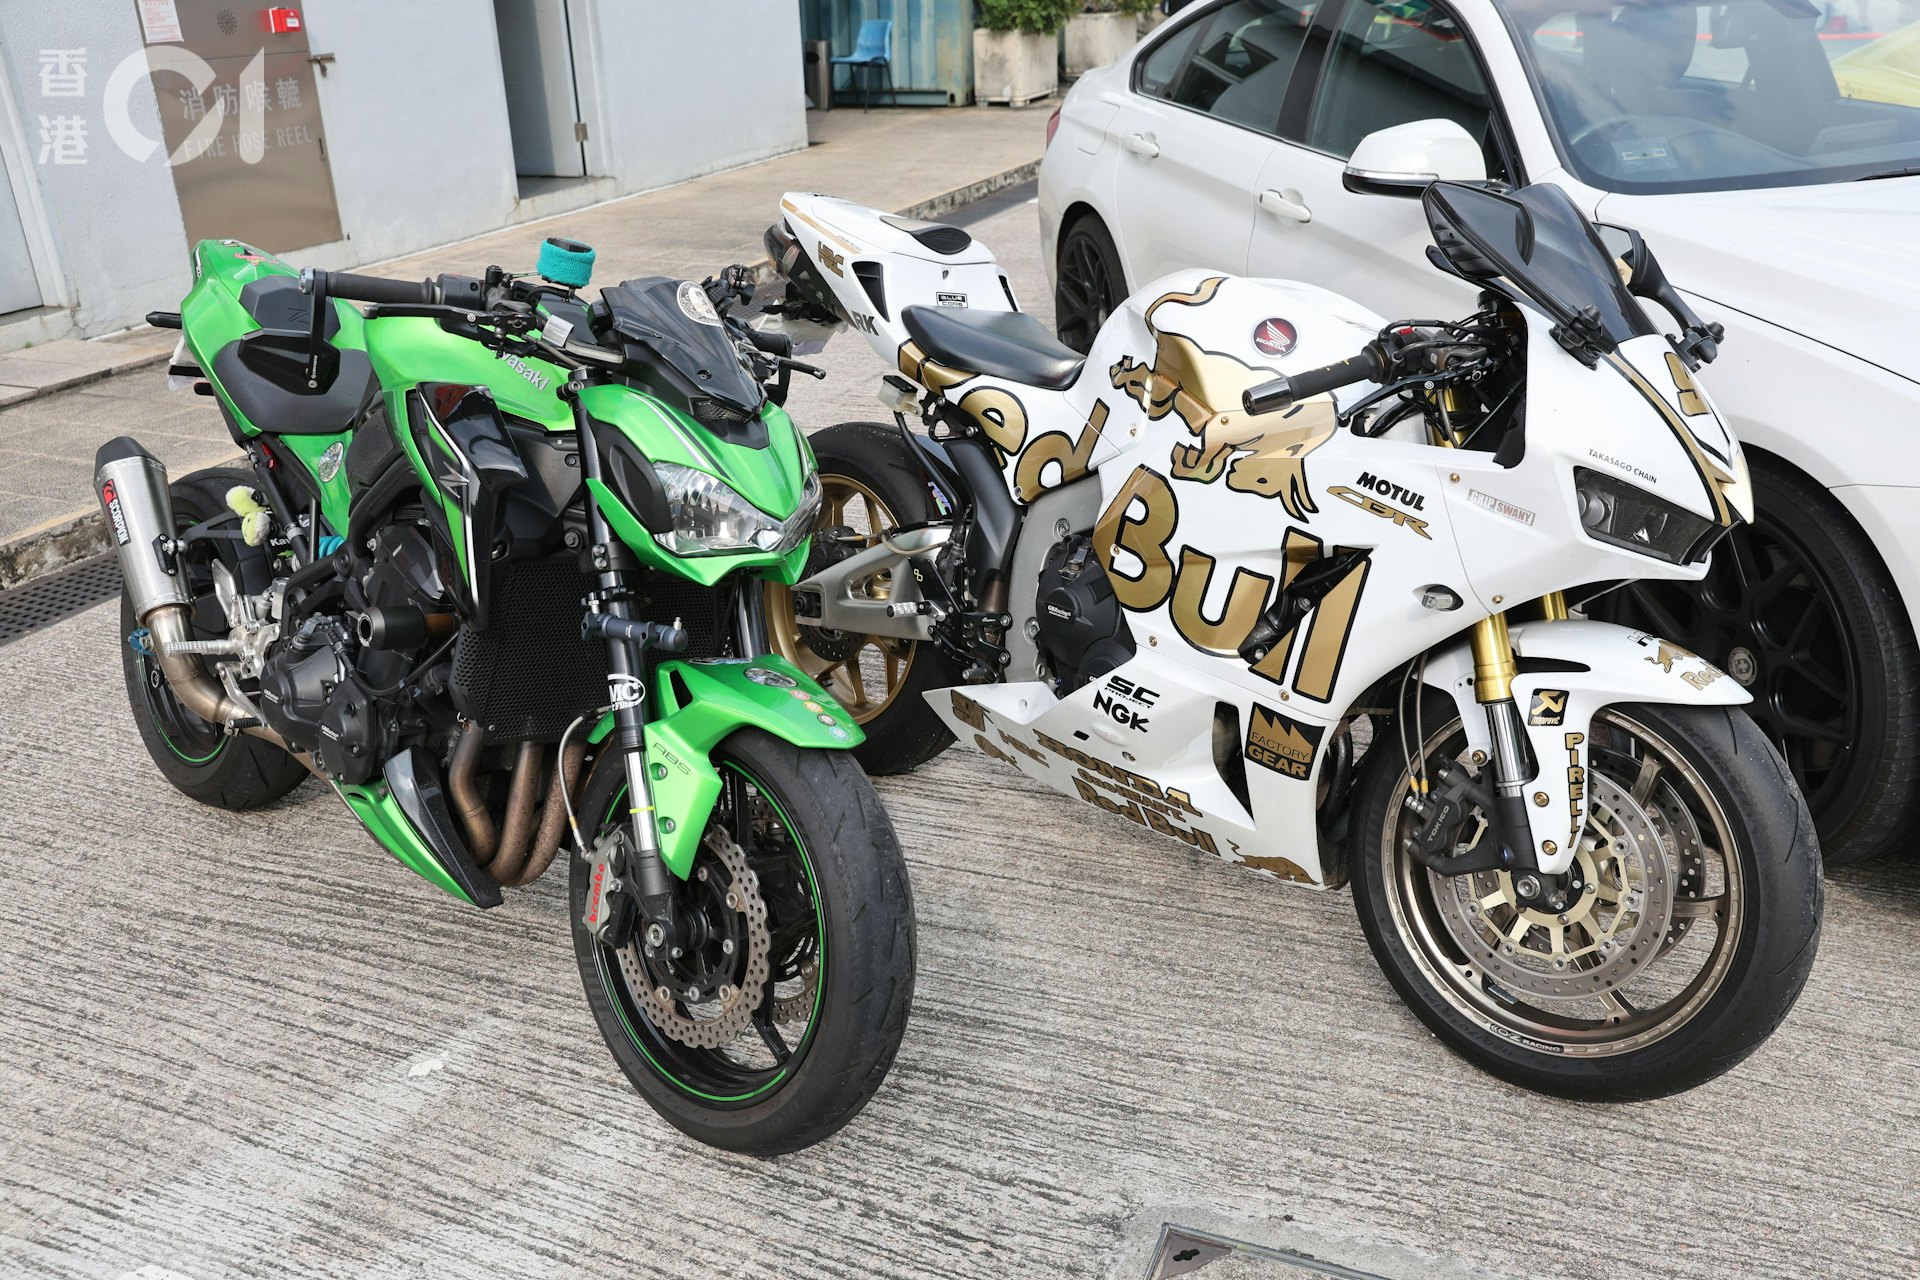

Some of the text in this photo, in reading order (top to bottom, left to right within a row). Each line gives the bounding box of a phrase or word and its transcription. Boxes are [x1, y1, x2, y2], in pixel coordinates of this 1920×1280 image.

[276, 124, 312, 147] REEL
[852, 311, 880, 337] RK
[1588, 448, 1657, 484] TAKASAGO CHAIN
[1356, 471, 1425, 512] MOTUL
[1470, 490, 1532, 523] GRIP SWANY
[109, 498, 129, 545] SCORPION
[1326, 486, 1432, 541] CBR
[1104, 687, 1152, 709] PROJECT
[1106, 675, 1161, 706] SC
[1093, 689, 1149, 733] NGK
[653, 743, 691, 775] ABS
[1248, 745, 1308, 778] GEAR
[1252, 731, 1309, 761] FACTORY
[1033, 728, 1203, 818] HONDA
[1071, 775, 1221, 857] Red Bull
[1428, 805, 1450, 842] TOKICO
[588, 863, 605, 923] brembo
[1523, 1038, 1560, 1053] RACING
